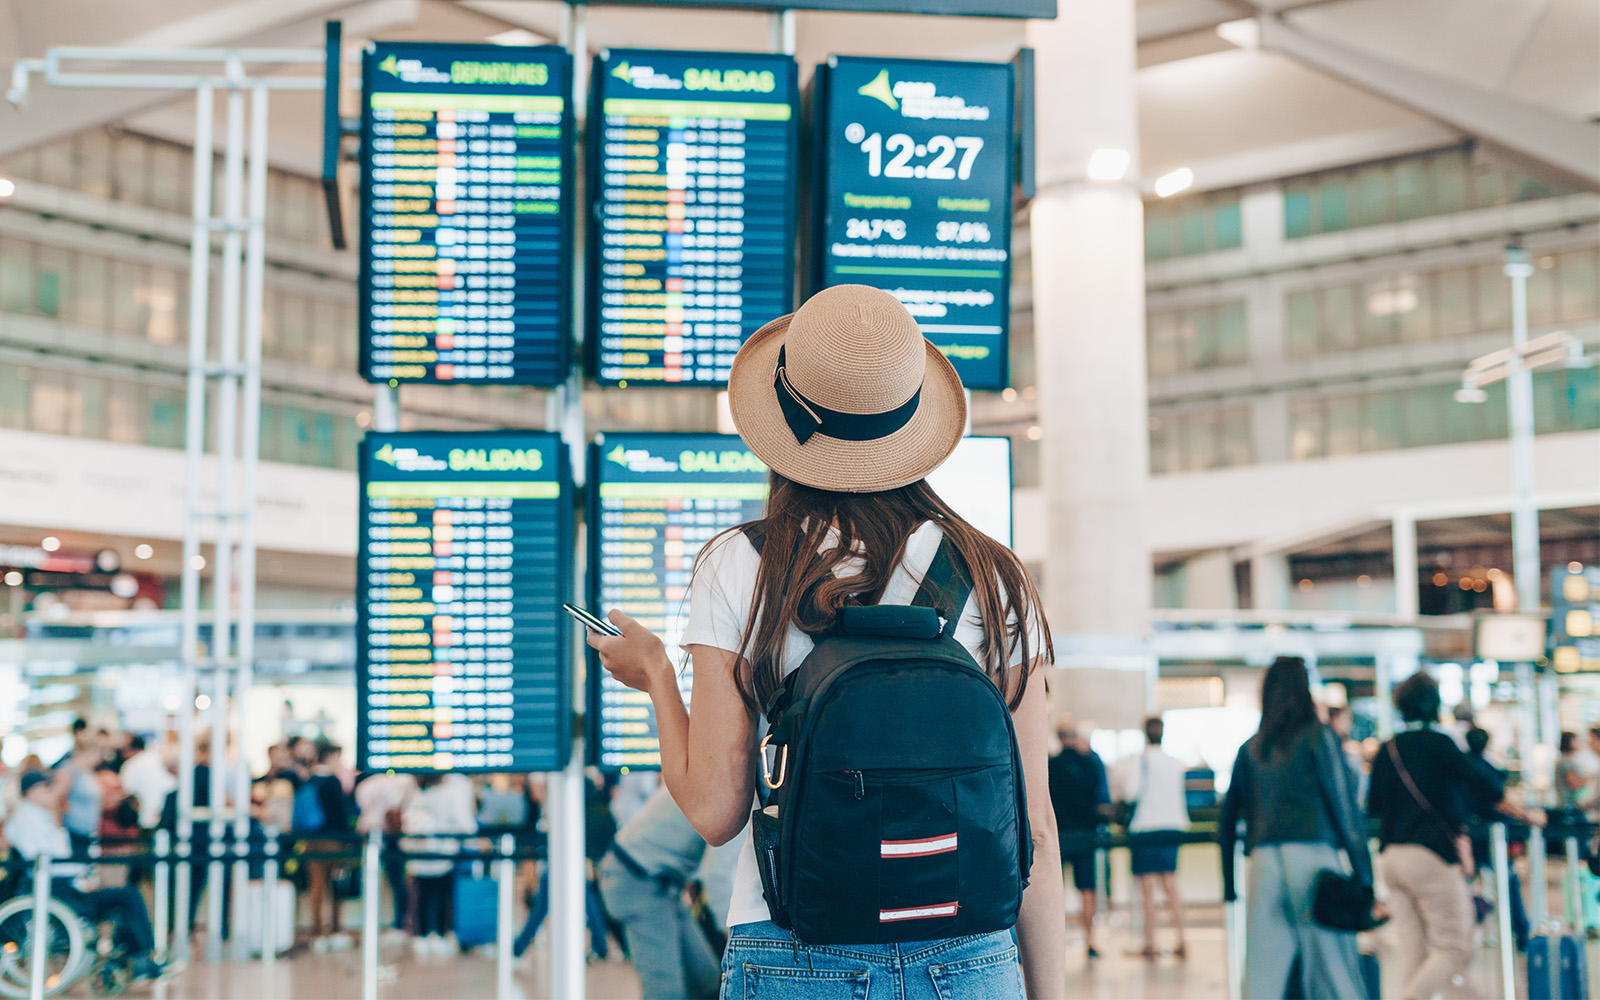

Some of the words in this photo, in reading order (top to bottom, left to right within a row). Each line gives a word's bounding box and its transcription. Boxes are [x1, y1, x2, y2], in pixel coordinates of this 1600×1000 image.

[451, 61, 549, 86] DEPARTURES
[683, 68, 776, 93] SALIDAS
[860, 132, 984, 180] 12:27
[448, 448, 543, 472] SALIDAS
